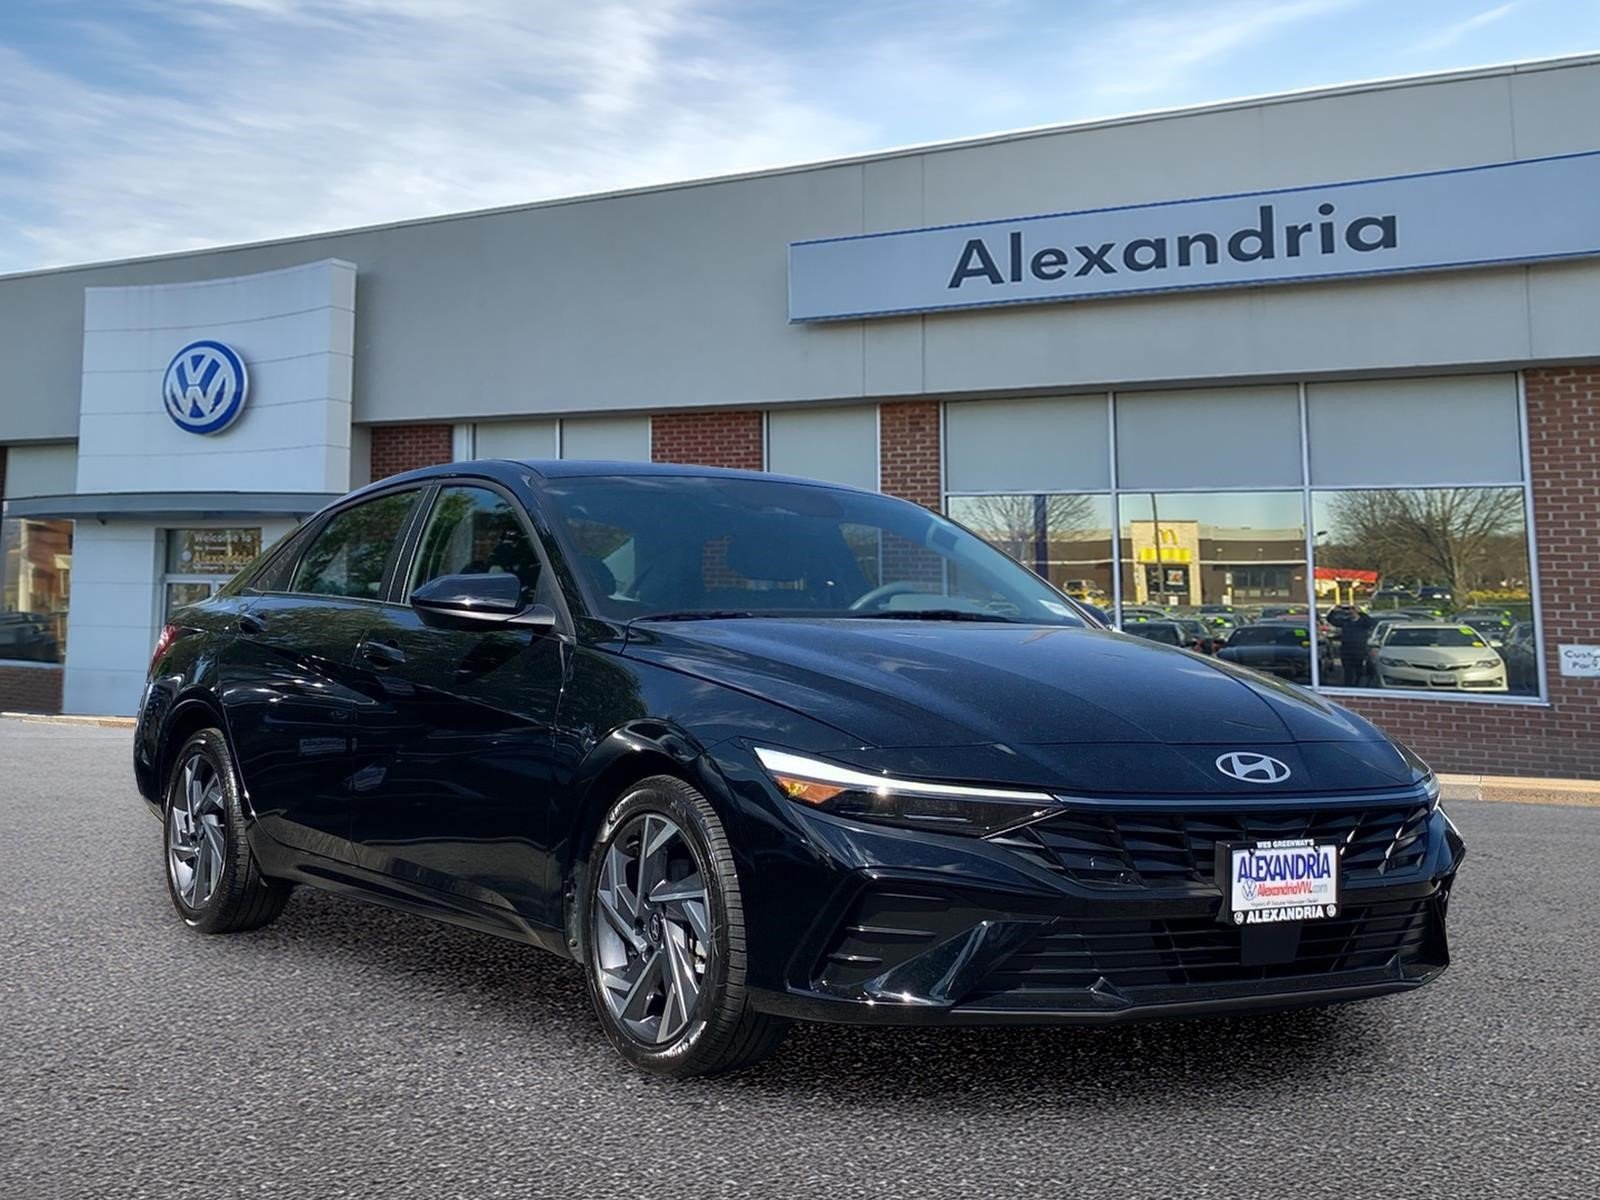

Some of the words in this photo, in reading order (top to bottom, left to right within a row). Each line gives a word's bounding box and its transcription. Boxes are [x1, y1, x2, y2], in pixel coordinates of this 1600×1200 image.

[948, 202, 1397, 289] Alexandria
[1237, 852, 1331, 883] ALEXANDRIA
[1246, 905, 1324, 924] ALEXANDRIA
